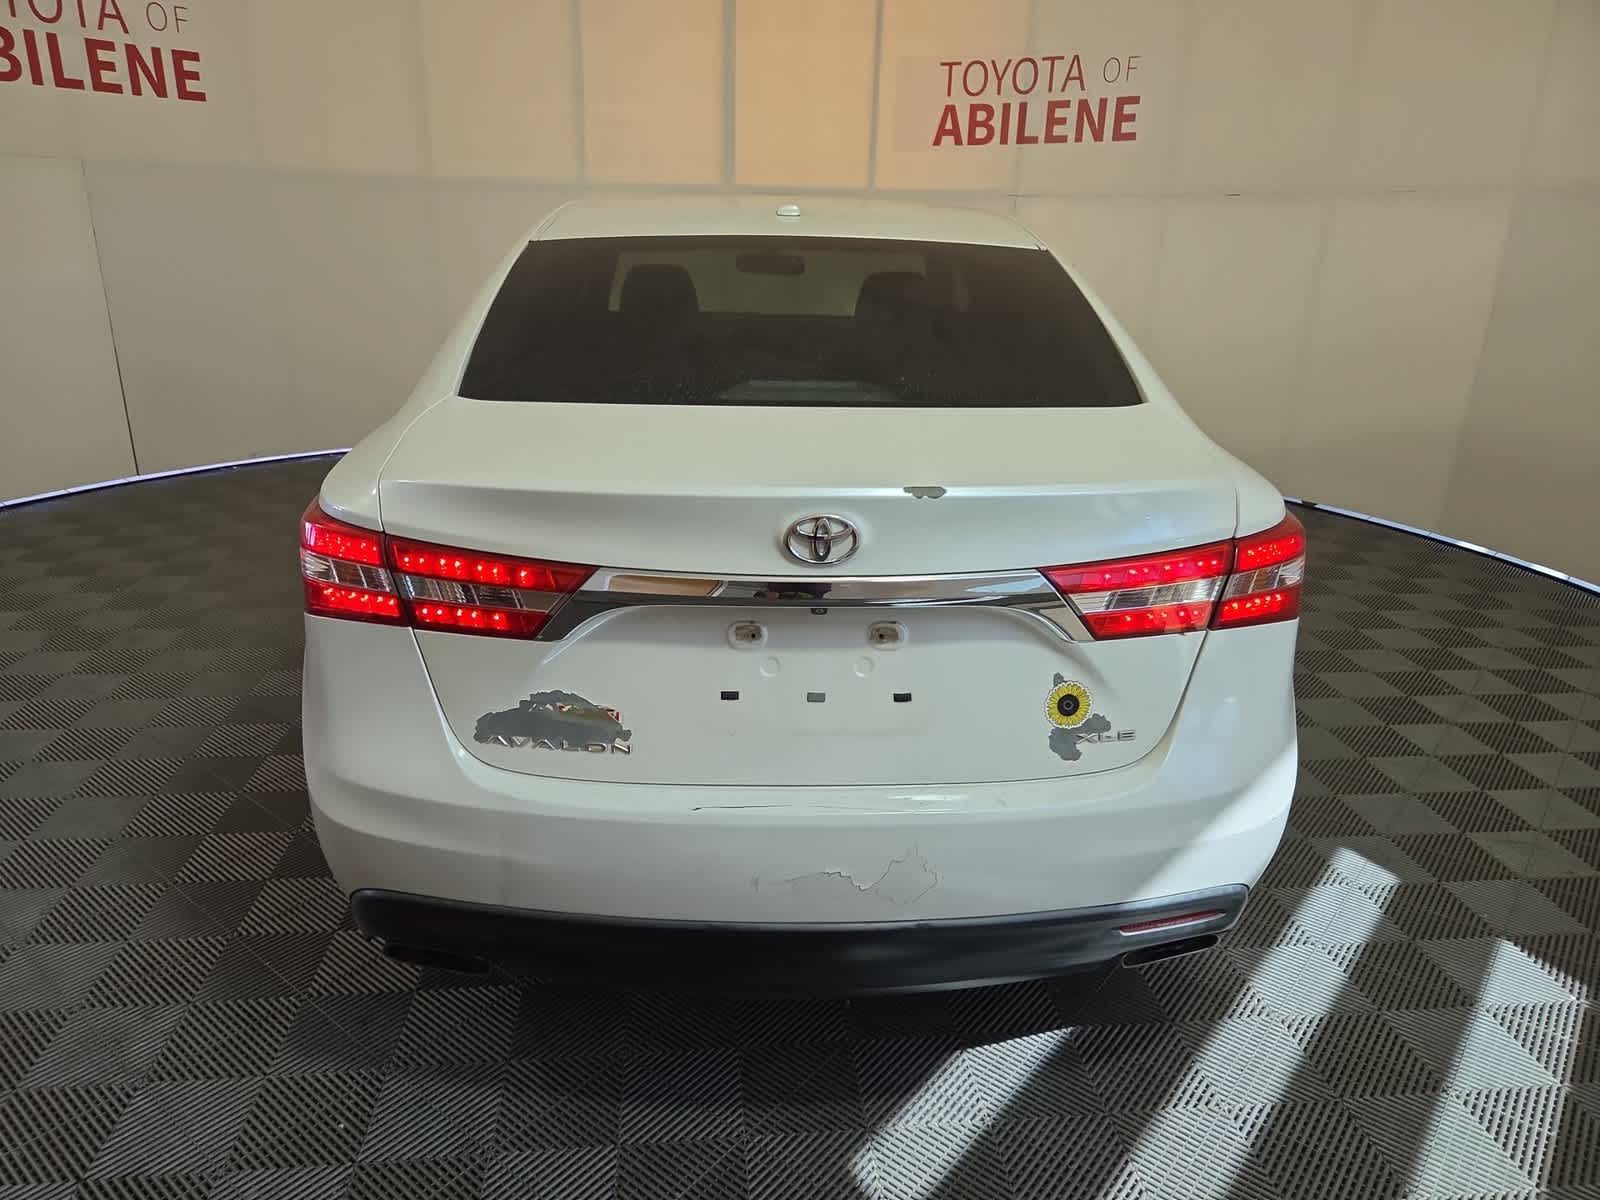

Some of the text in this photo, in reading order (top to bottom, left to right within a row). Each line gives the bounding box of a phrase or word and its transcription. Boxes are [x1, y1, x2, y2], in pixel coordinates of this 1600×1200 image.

[146, 1, 188, 33] OF
[940, 54, 1141, 97] TOYOTA OF
[932, 96, 1141, 146] ABILENE
[486, 735, 633, 755] AVALON
[1075, 730, 1136, 743] XLE
